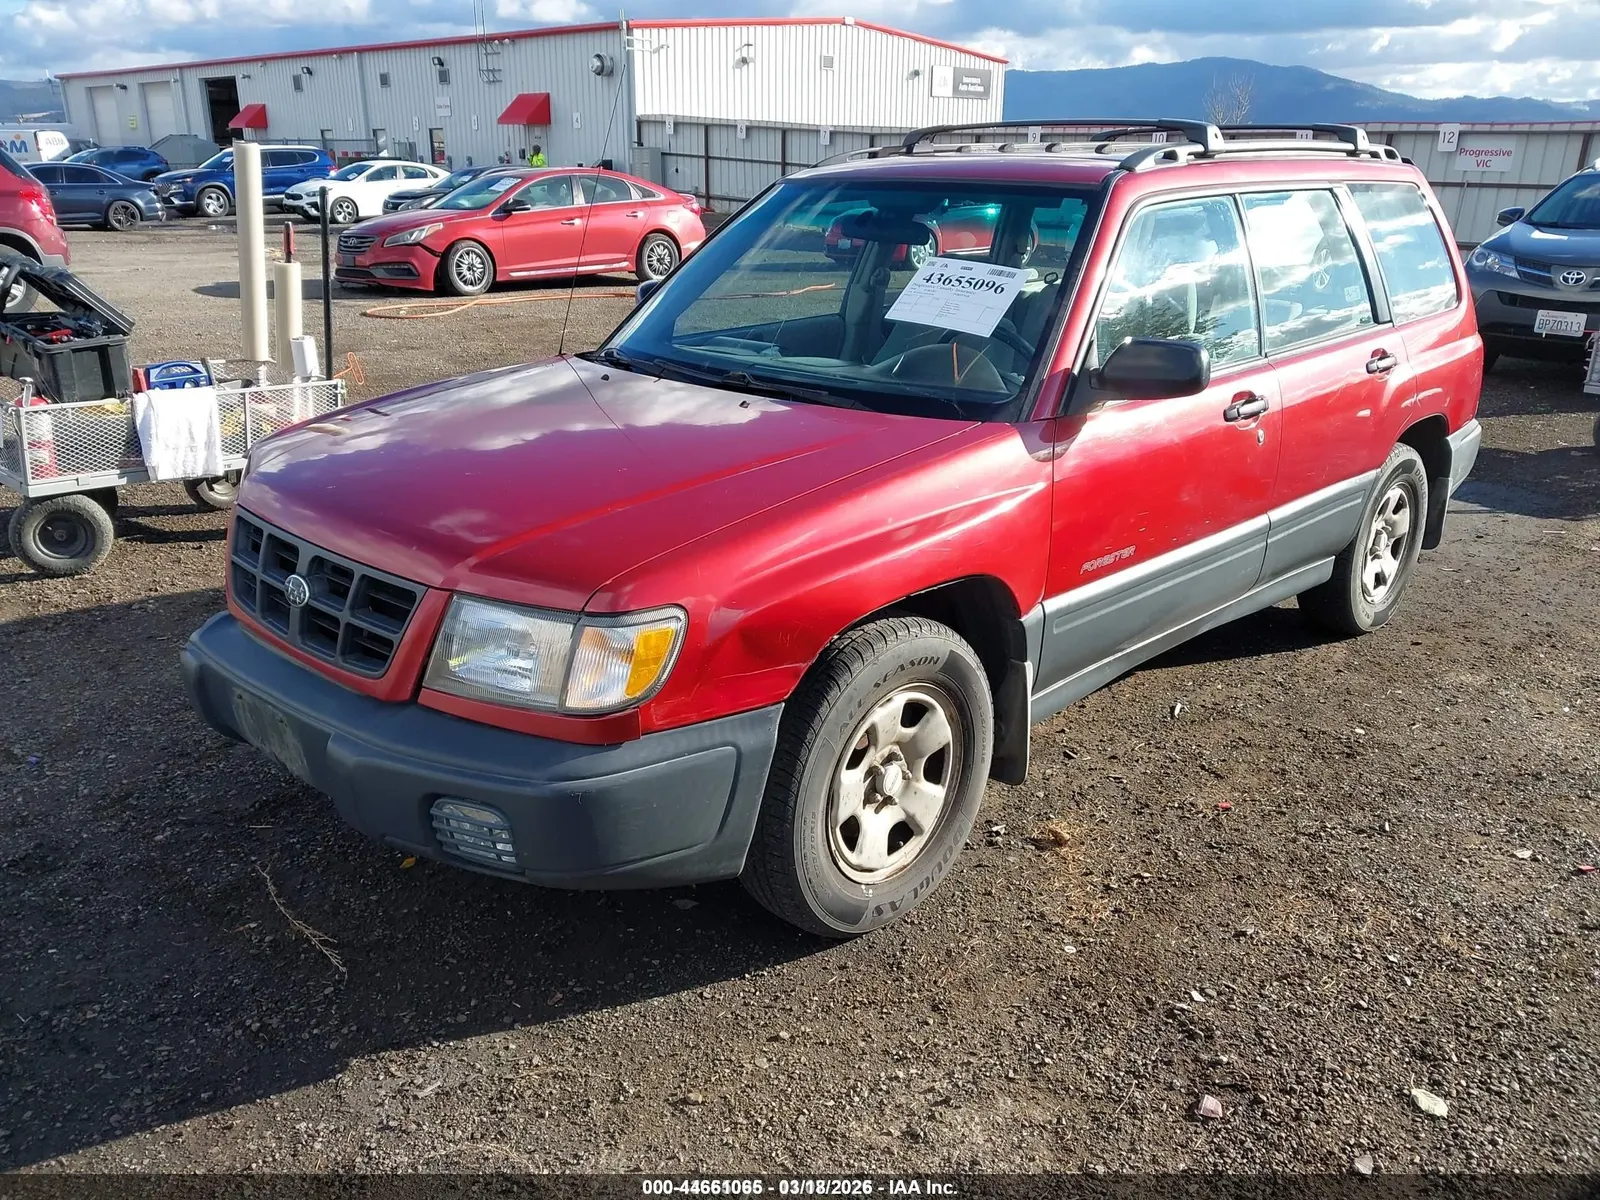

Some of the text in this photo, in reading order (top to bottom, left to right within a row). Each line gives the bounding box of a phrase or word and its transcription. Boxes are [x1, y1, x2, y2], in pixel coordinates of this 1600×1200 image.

[1154, 133, 1164, 142] 10
[1442, 131, 1455, 144] 12
[1459, 148, 1512, 157] Progressive
[1476, 160, 1492, 168] VIC
[922, 272, 1008, 294] 43655096
[1538, 318, 1581, 333] BPZ0313
[1080, 545, 1136, 574] FORESTER
[839, 656, 940, 739] ALL SEASON
[872, 823, 964, 918] DOUGLAS
